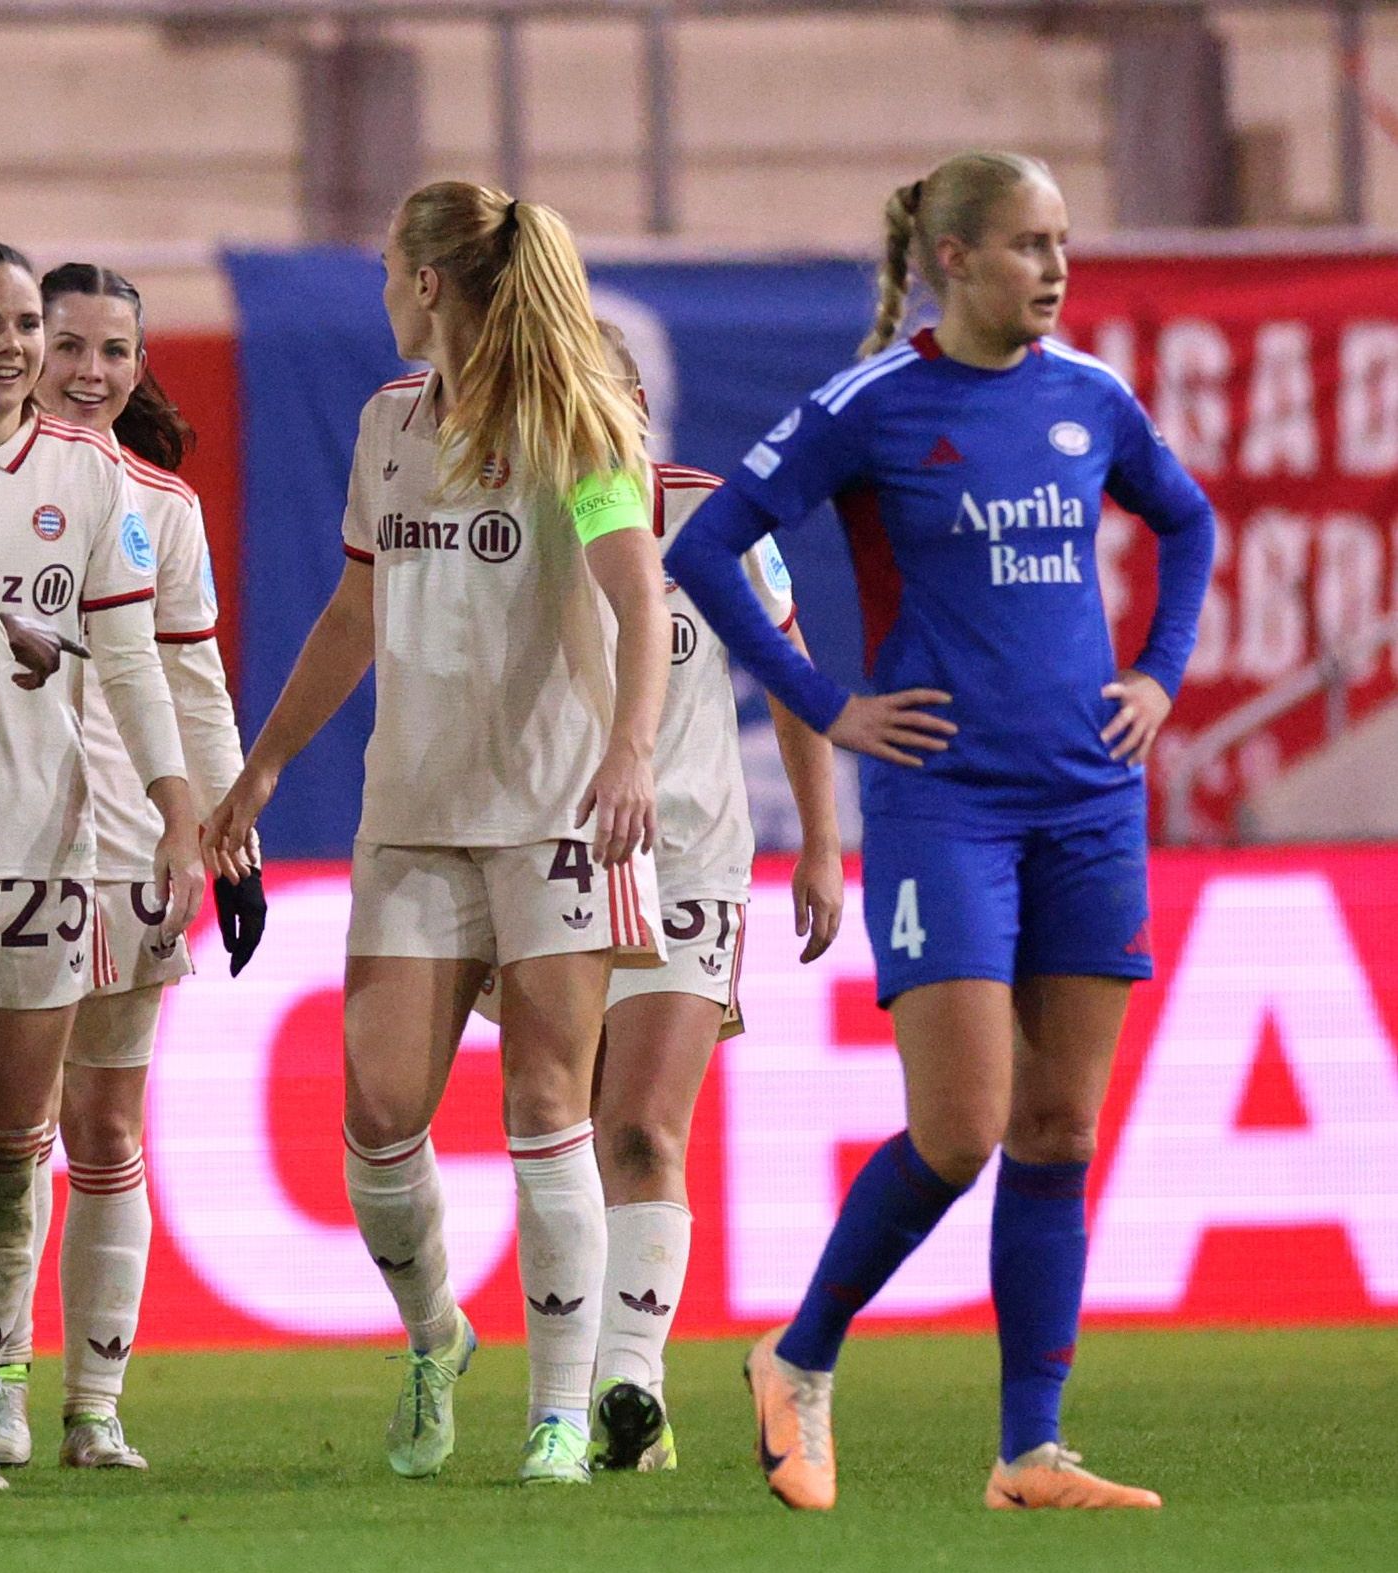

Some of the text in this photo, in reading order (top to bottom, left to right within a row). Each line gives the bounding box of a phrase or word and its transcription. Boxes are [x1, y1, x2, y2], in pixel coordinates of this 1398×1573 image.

[376, 512, 459, 552] Allianz
[951, 481, 1084, 542] Aprila
[990, 540, 1083, 586] Bank
[547, 839, 595, 894] 4
[0, 878, 88, 948] 25
[891, 878, 927, 960] 4
